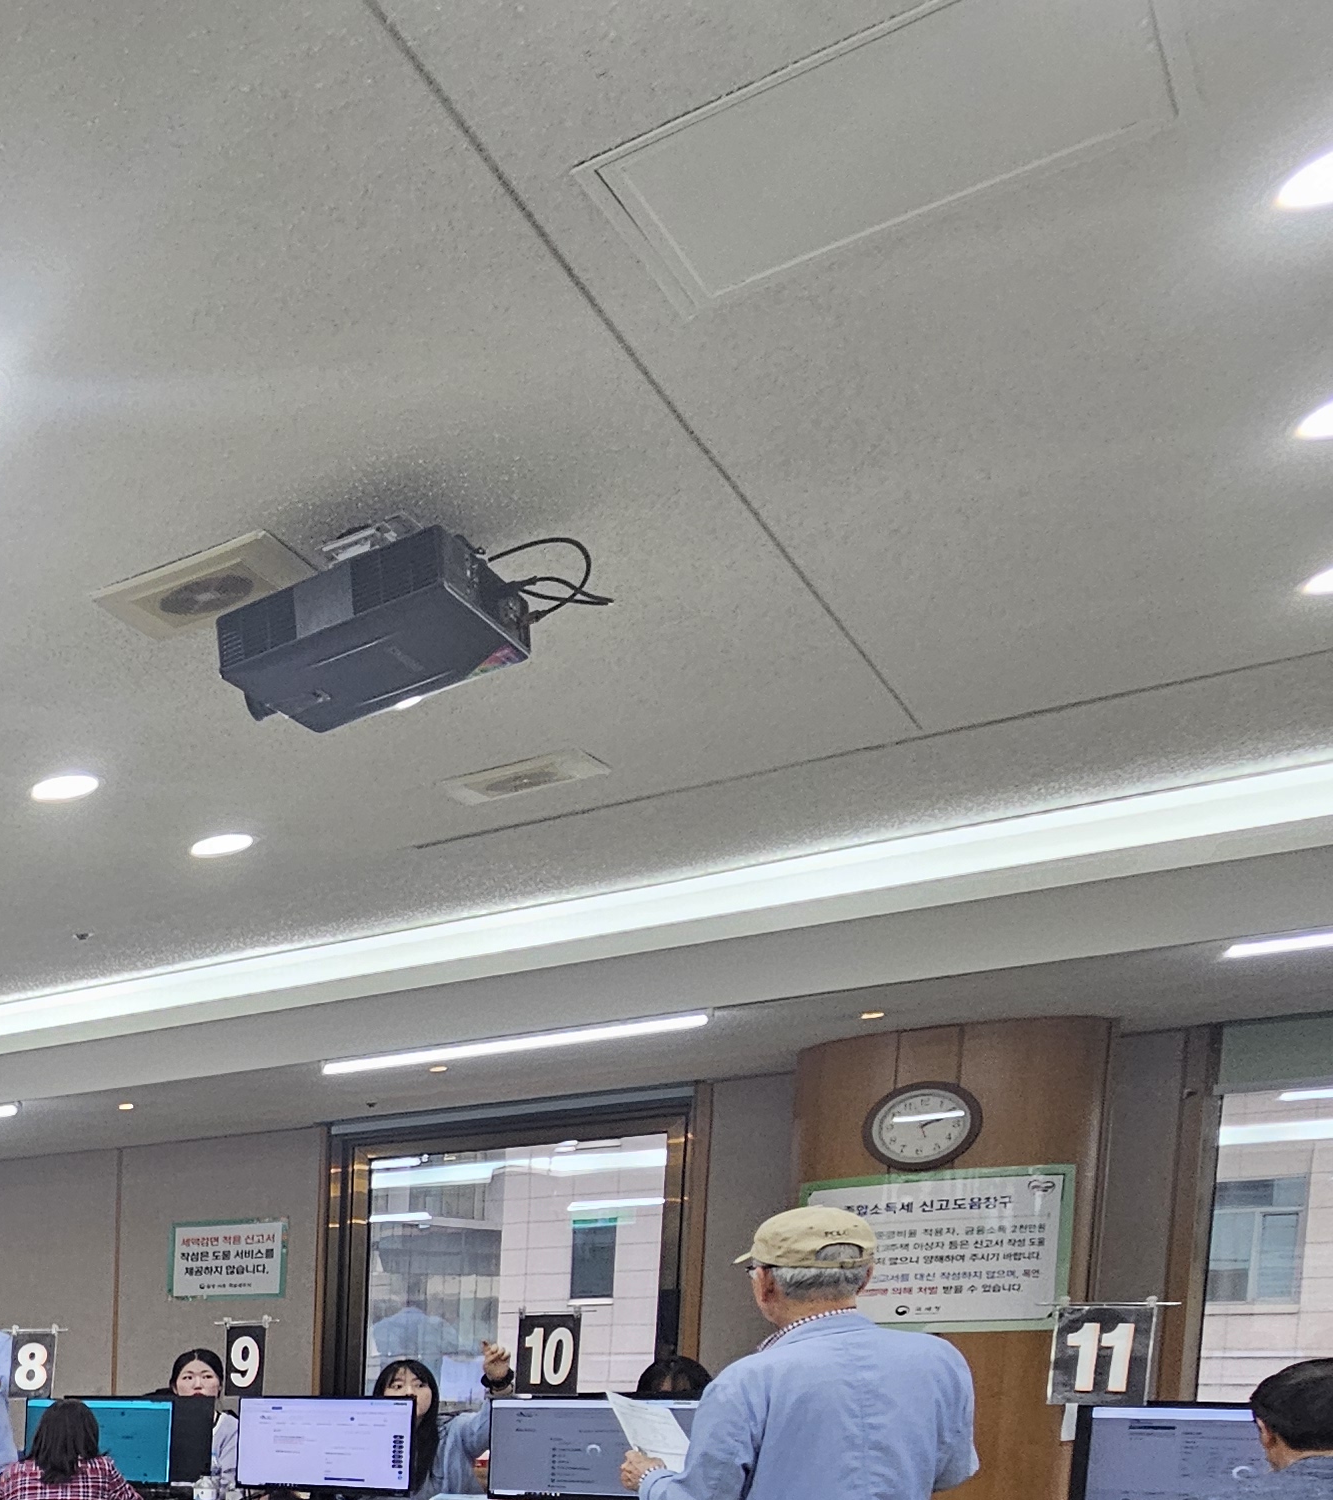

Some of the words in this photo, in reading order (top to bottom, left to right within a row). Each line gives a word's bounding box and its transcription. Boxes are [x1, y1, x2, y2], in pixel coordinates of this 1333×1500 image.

[244, 1233, 276, 1245] 신고서
[973, 1239, 1004, 1249] 신고서
[180, 1251, 209, 1262] 작성은
[234, 1248, 275, 1260] 서비스를
[923, 1254, 966, 1264] 양해하여
[969, 1252, 1000, 1262] 주시기
[184, 1265, 223, 1276] 제공하지
[225, 1263, 270, 1275] 않습니다.
[940, 1270, 983, 1280] 작성하지
[966, 1284, 978, 1293] 수
[230, 1336, 260, 1387] 9
[524, 1326, 574, 1386] 10
[1066, 1321, 1135, 1393] 11
[14, 1341, 48, 1391] 8
